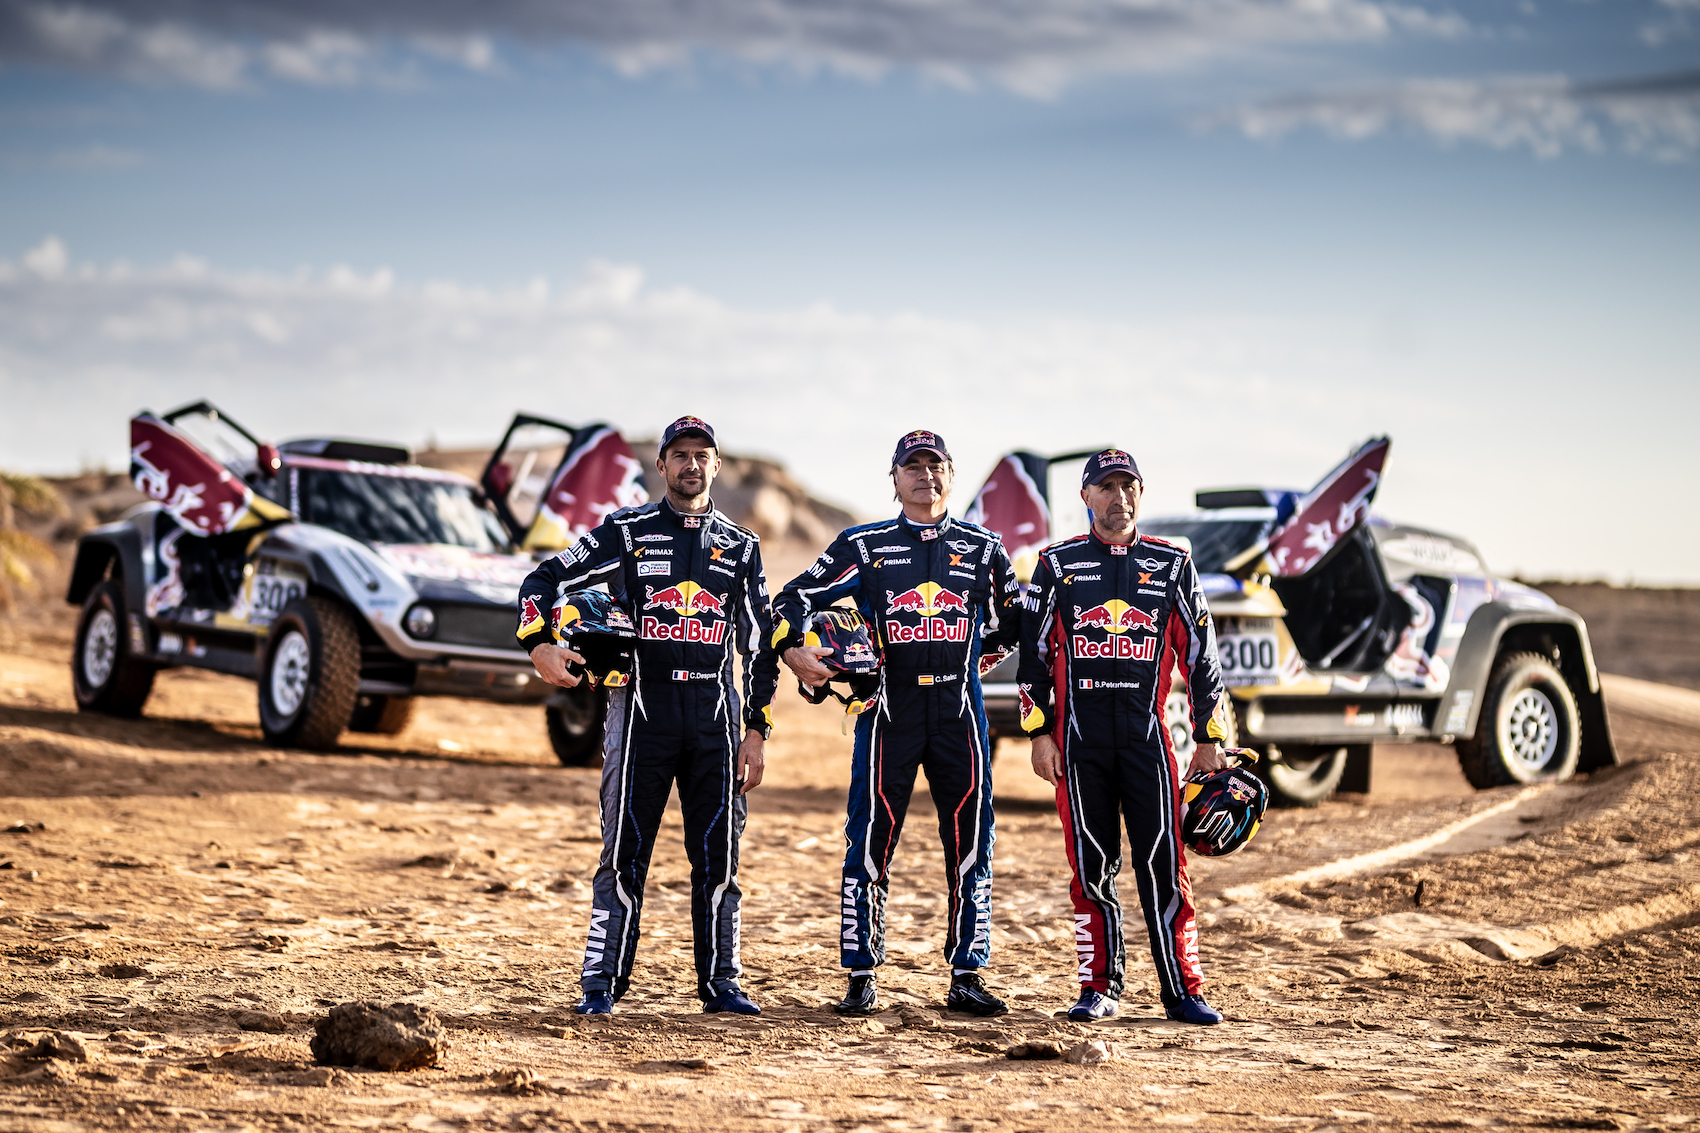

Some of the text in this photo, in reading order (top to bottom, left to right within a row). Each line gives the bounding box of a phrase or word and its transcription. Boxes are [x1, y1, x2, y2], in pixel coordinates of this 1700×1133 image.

[883, 558, 912, 566] PRIMAX
[642, 616, 726, 645] Red Bull
[886, 617, 968, 644] Red Bull
[1073, 634, 1157, 661] Red Bull
[1219, 640, 1274, 671] 300
[843, 877, 859, 951] MINI
[972, 878, 993, 949] MINI
